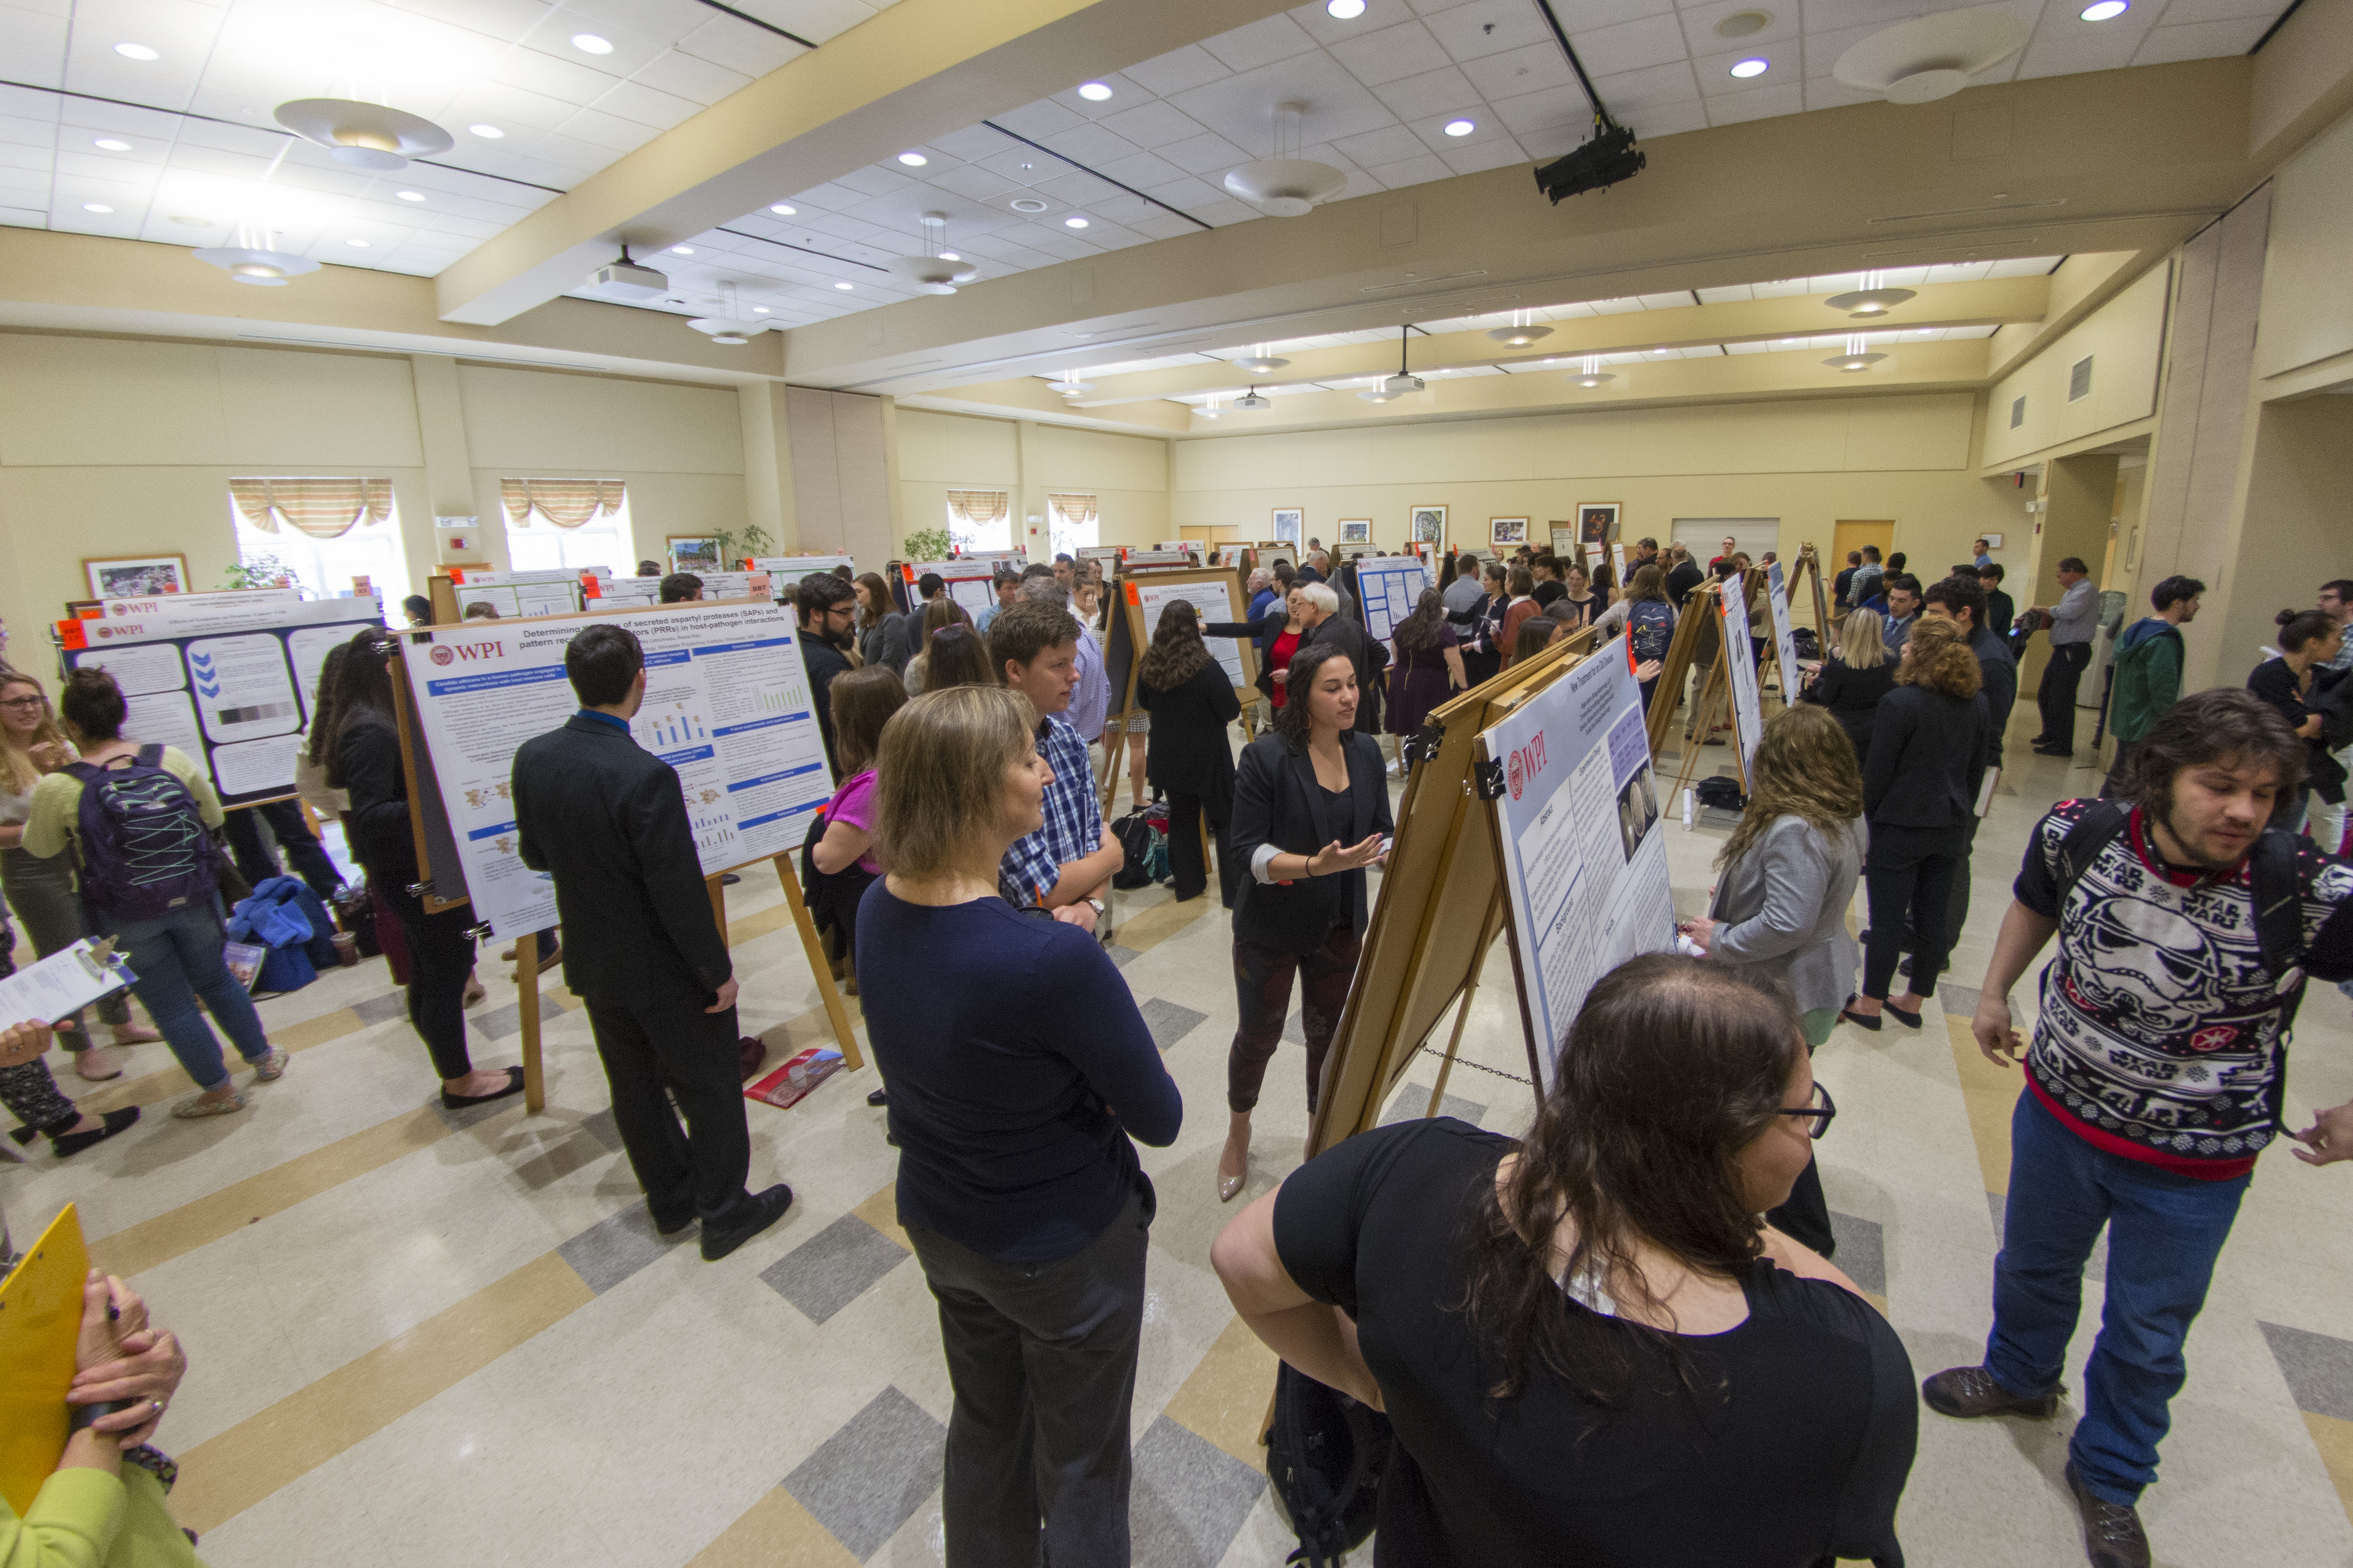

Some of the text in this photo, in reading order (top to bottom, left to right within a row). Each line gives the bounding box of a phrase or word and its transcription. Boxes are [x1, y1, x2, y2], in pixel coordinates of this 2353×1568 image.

[128, 602, 159, 614] WPI
[113, 625, 144, 635] WPI
[519, 637, 553, 650] pattern
[652, 626, 679, 636] (PRRs)
[690, 620, 743, 630] host-pathogen
[744, 615, 784, 625] interactions
[524, 626, 580, 637] Determining
[634, 618, 668, 627] secreted
[671, 614, 701, 625] aspartyl
[703, 612, 738, 621] proteases
[740, 609, 764, 618] (SAPs)
[454, 641, 505, 661] WPI
[444, 685, 467, 693] dynamic
[468, 681, 499, 689] interactions
[459, 678, 481, 686] albicans
[510, 670, 533, 679] pathogen
[534, 667, 554, 676] engaged
[1577, 670, 1593, 687] Treatment
[743, 722, 766, 730] experiments
[1522, 729, 1547, 783] WPI
[1580, 745, 1601, 776] Experimental Design
[777, 808, 797, 817] References
[1540, 804, 1553, 826] Abstract
[2092, 858, 2144, 891] WARS
[2103, 854, 2144, 879] STAR
[1555, 895, 1574, 934] Background
[2181, 895, 2241, 917] STAR
[2181, 903, 2240, 930] WARS
[1606, 918, 1615, 936] Results
[2109, 1050, 2180, 1072] STAR
[2109, 1056, 2180, 1080] WARS
